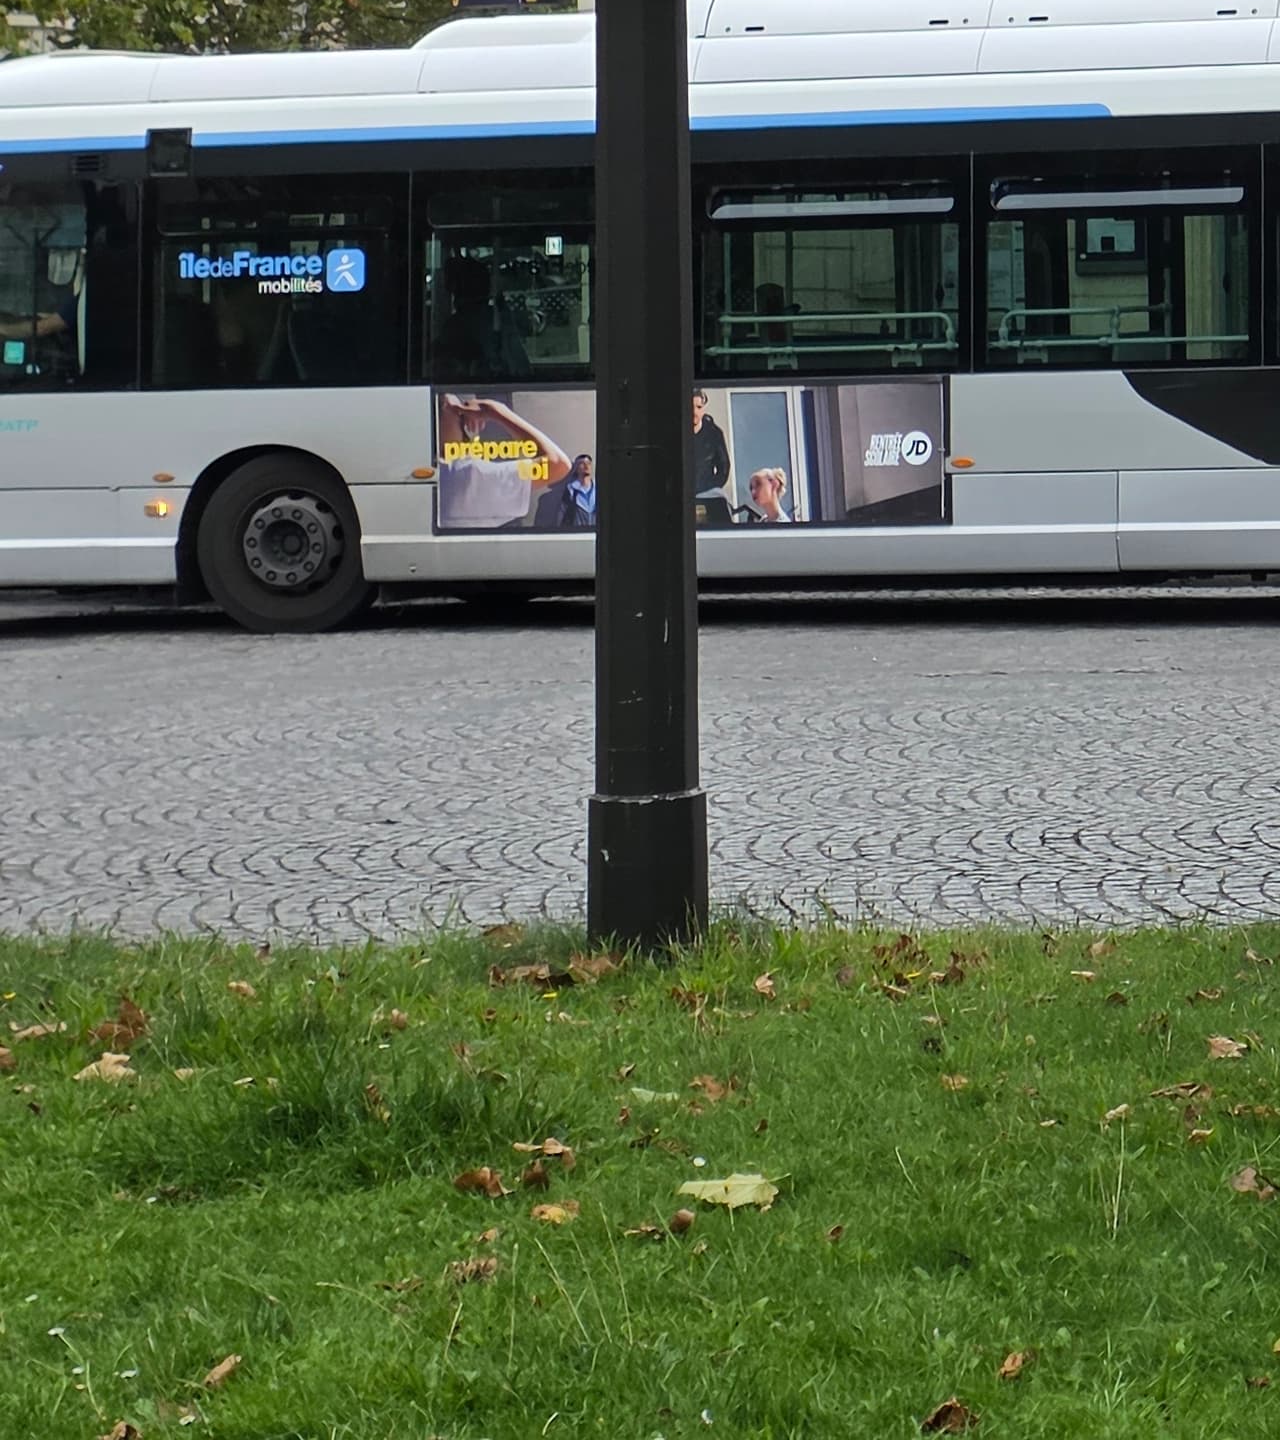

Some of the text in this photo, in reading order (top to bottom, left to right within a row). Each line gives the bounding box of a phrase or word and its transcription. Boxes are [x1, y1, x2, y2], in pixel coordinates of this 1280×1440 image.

[258, 276, 323, 294] mobilités
[444, 435, 538, 464] prépare
[906, 439, 928, 457] JD
